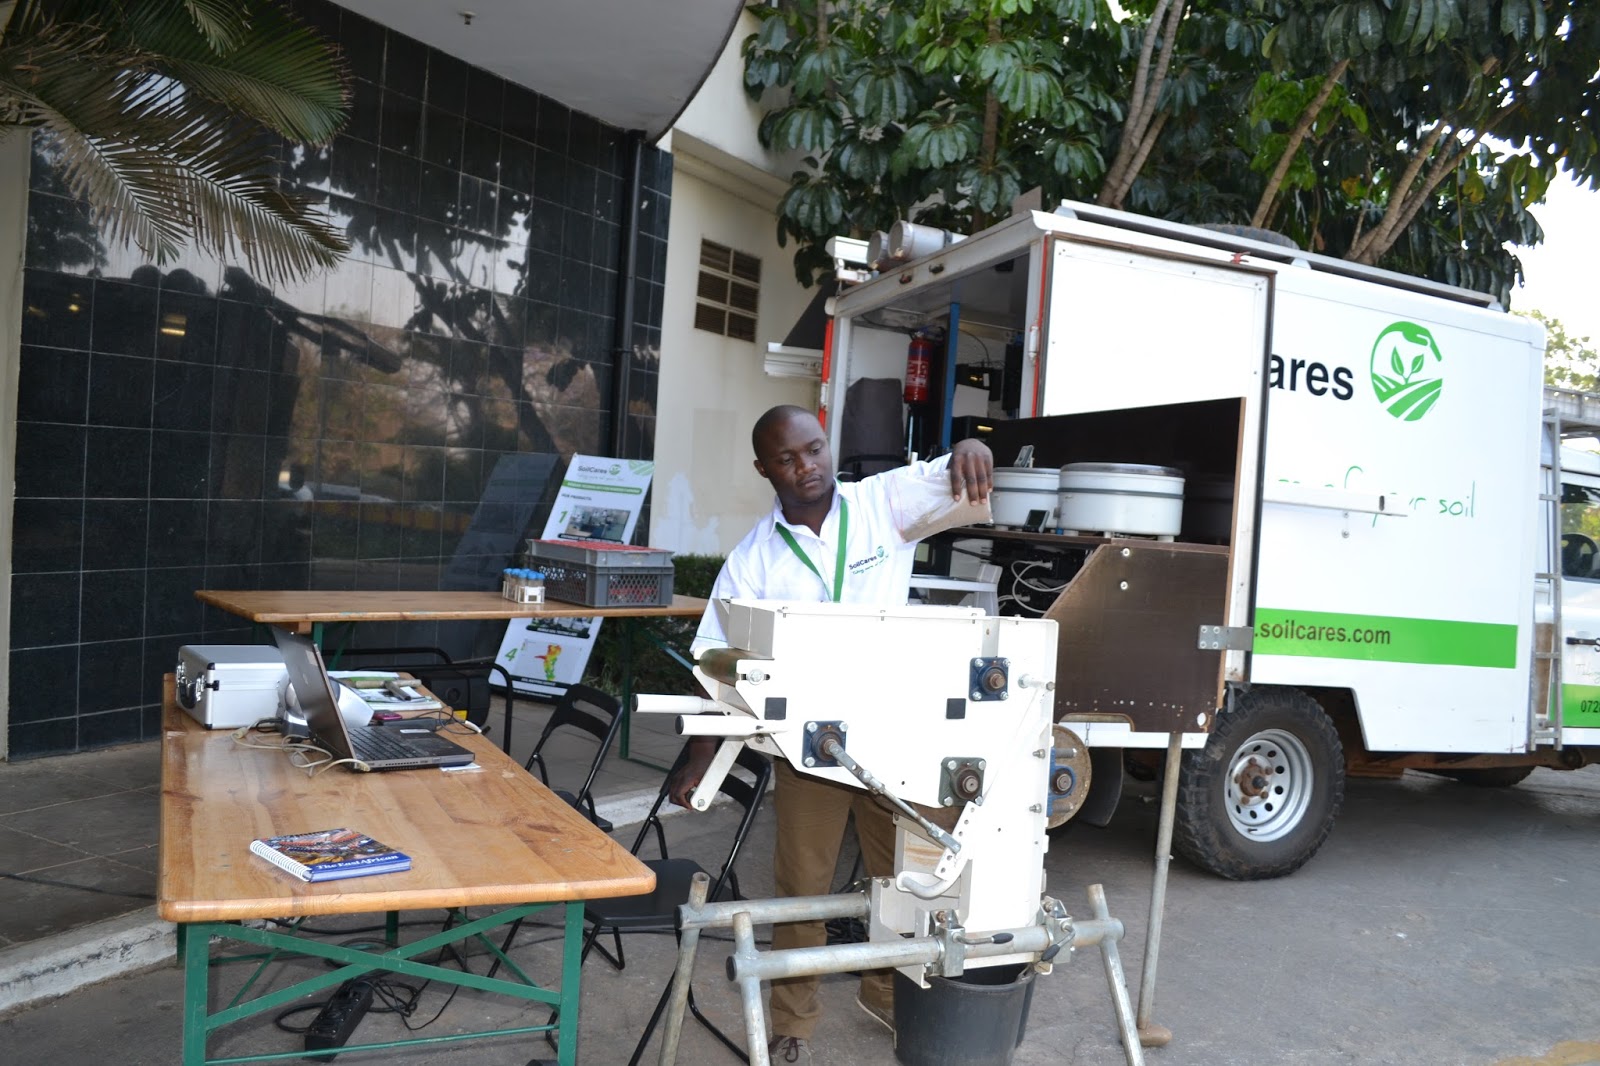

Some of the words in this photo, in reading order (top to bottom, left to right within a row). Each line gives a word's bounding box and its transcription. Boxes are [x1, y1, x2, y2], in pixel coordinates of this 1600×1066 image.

[577, 465, 607, 474] SoilCares
[1439, 481, 1476, 519] soil
[559, 510, 568, 524] 1
[849, 556, 877, 570] SoilCares
[505, 648, 517, 661] 4
[1580, 699, 1600, 713] 072
[338, 859, 360, 867] East
[361, 855, 399, 864] African
